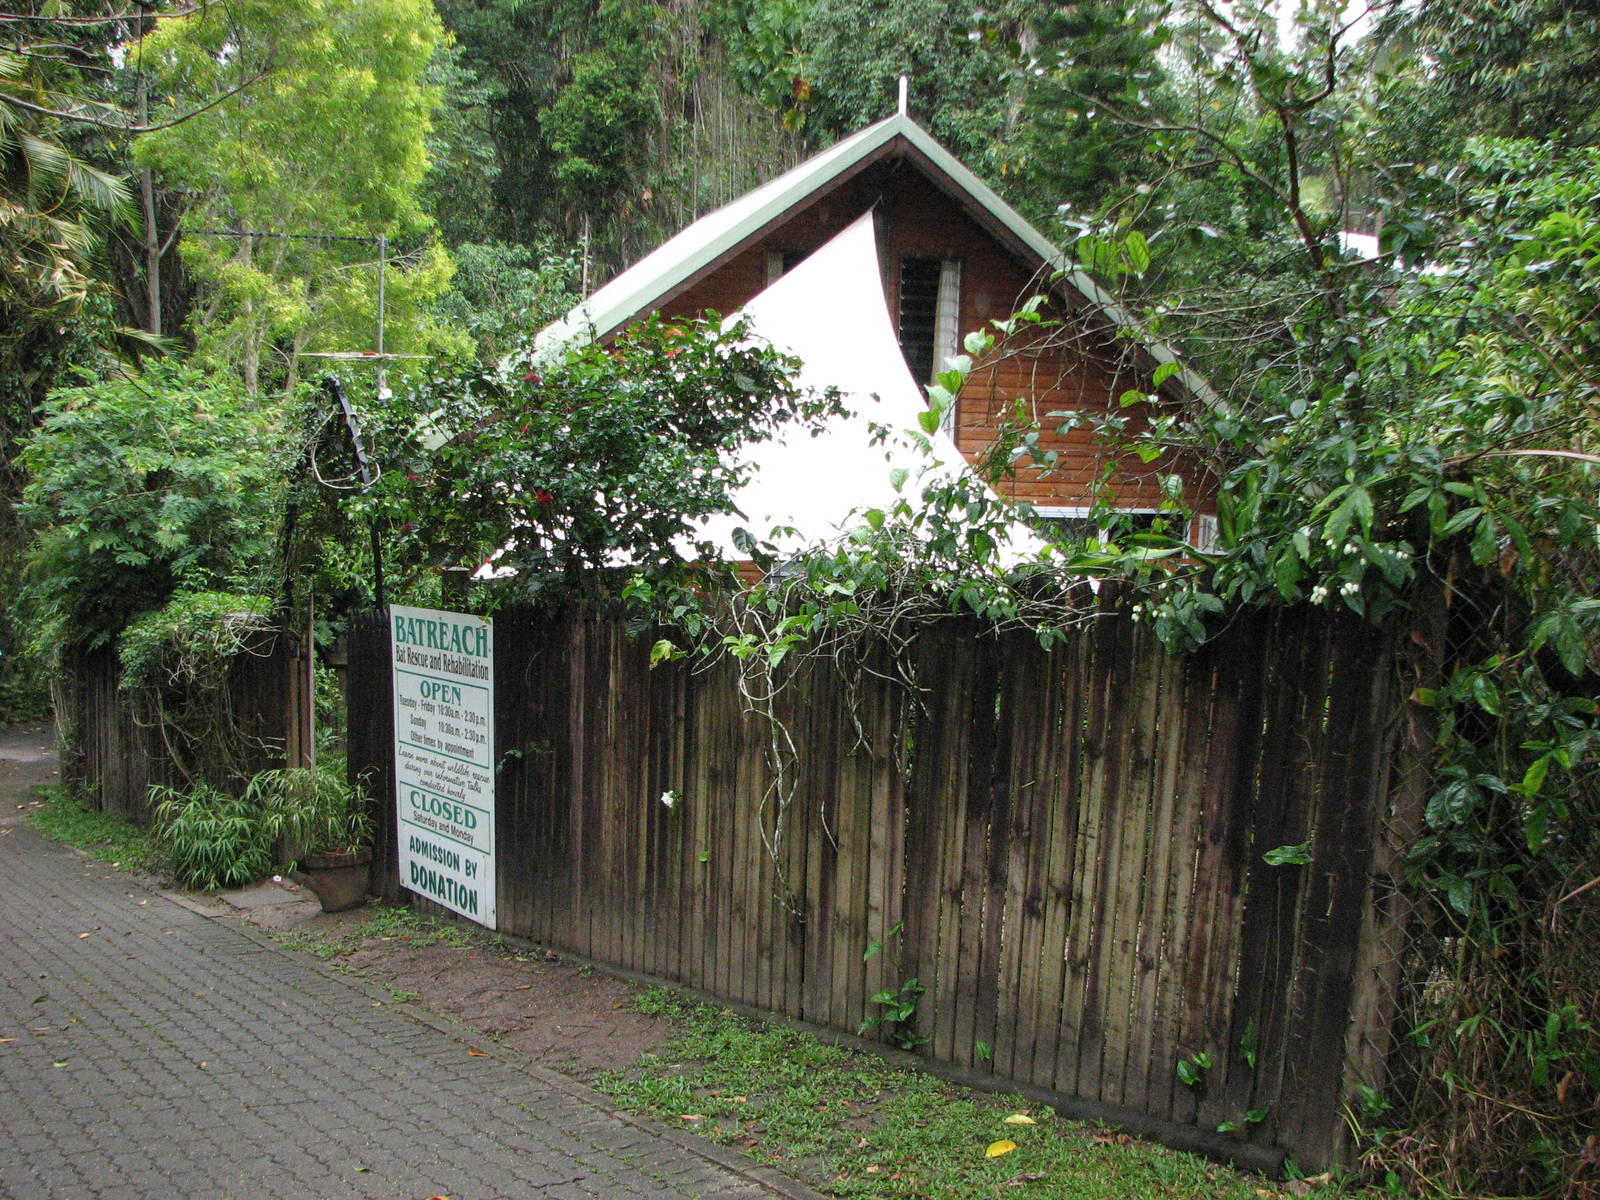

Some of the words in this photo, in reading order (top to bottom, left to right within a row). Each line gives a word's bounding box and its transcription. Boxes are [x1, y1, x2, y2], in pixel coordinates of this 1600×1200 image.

[395, 616, 489, 658] BATREACH
[396, 645, 406, 663] Bat
[407, 648, 429, 667] Rescue
[430, 655, 441, 671] and
[443, 655, 489, 681] Rehabilitation
[420, 680, 462, 706] OPEN
[421, 699, 436, 716] Friday
[410, 713, 427, 730] Sunday
[410, 730, 423, 743] Other
[423, 733, 437, 748] times
[437, 738, 443, 752] by
[445, 742, 475, 759] appointment
[430, 757, 447, 769] about
[447, 762, 470, 777] wildlife
[467, 780, 482, 794] talks
[410, 790, 478, 830] CLOSED
[413, 810, 438, 831] Saturday
[439, 819, 450, 834] and
[450, 823, 475, 846] Monday
[410, 835, 460, 873] ADMISSION
[465, 858, 478, 881] BY
[410, 860, 478, 915] DONATION
